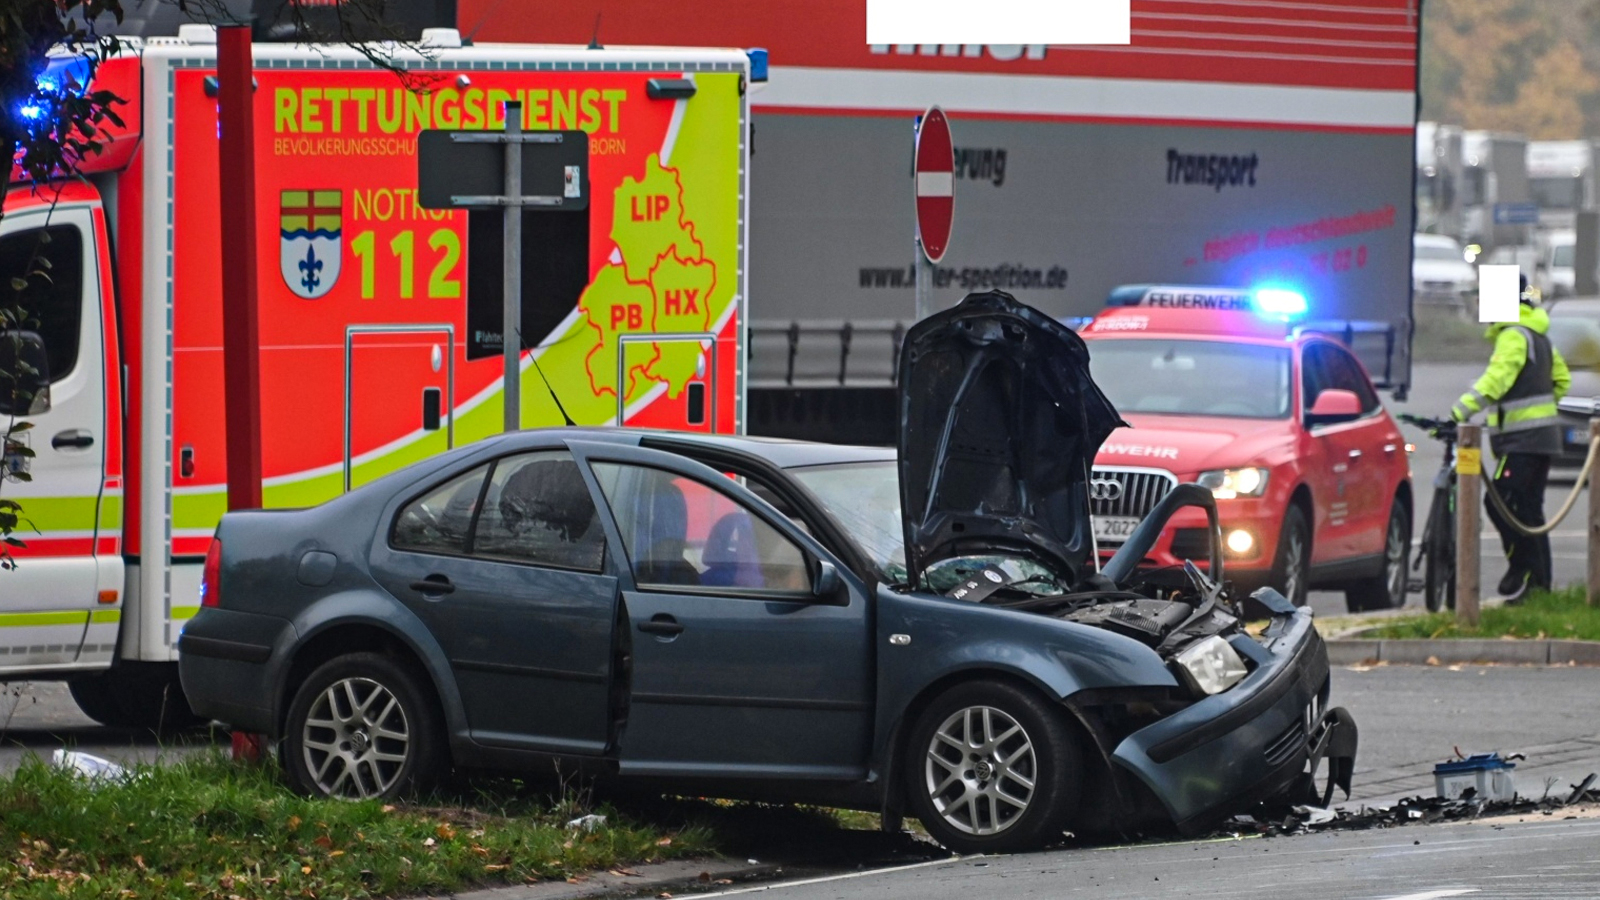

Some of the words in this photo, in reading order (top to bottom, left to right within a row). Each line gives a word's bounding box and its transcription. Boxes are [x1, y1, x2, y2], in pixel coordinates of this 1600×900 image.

[275, 88, 627, 133] RETTUNGSDIENST
[274, 136, 418, 156] BEVÖLKERUNGSSCHU
[590, 138, 626, 155] BORN
[1167, 148, 1259, 193] Transport
[353, 187, 454, 221] NOTR
[631, 195, 670, 222] LIP
[351, 228, 461, 299] 112
[665, 289, 699, 316] HX
[611, 304, 643, 331] PB
[1099, 444, 1179, 460] WEHR
